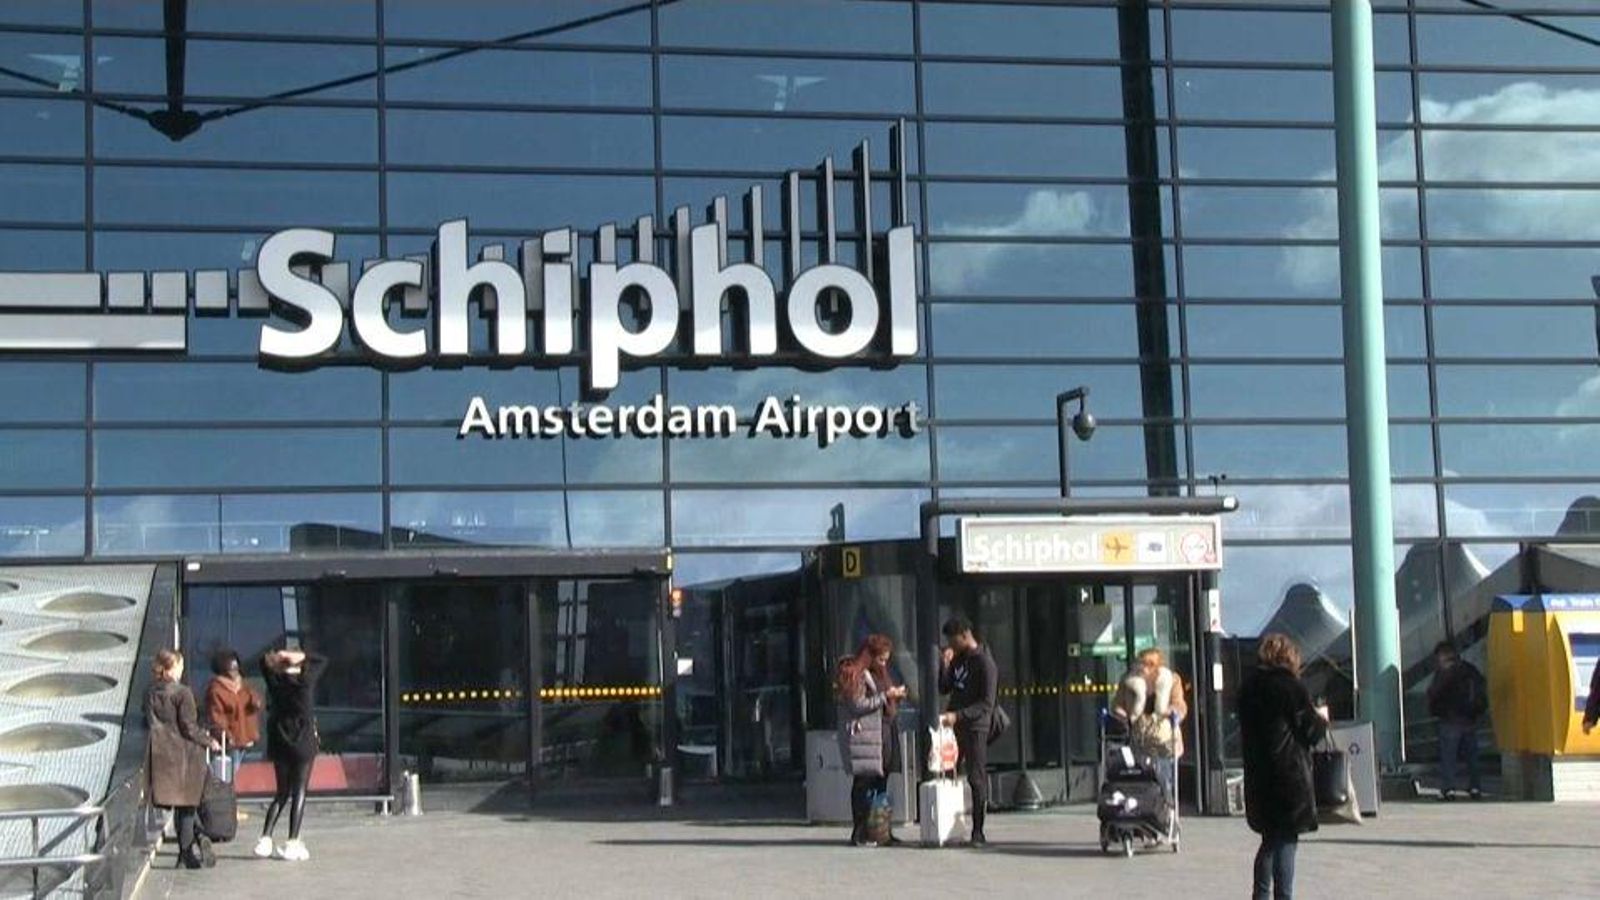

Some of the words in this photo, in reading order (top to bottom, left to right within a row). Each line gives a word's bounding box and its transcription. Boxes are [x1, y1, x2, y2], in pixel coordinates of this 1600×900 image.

[257, 218, 919, 390] Schiphol
[459, 394, 737, 435] Amsterdam
[755, 394, 922, 443] Airport
[845, 550, 857, 573] D
[973, 531, 1099, 564] Schiphol
